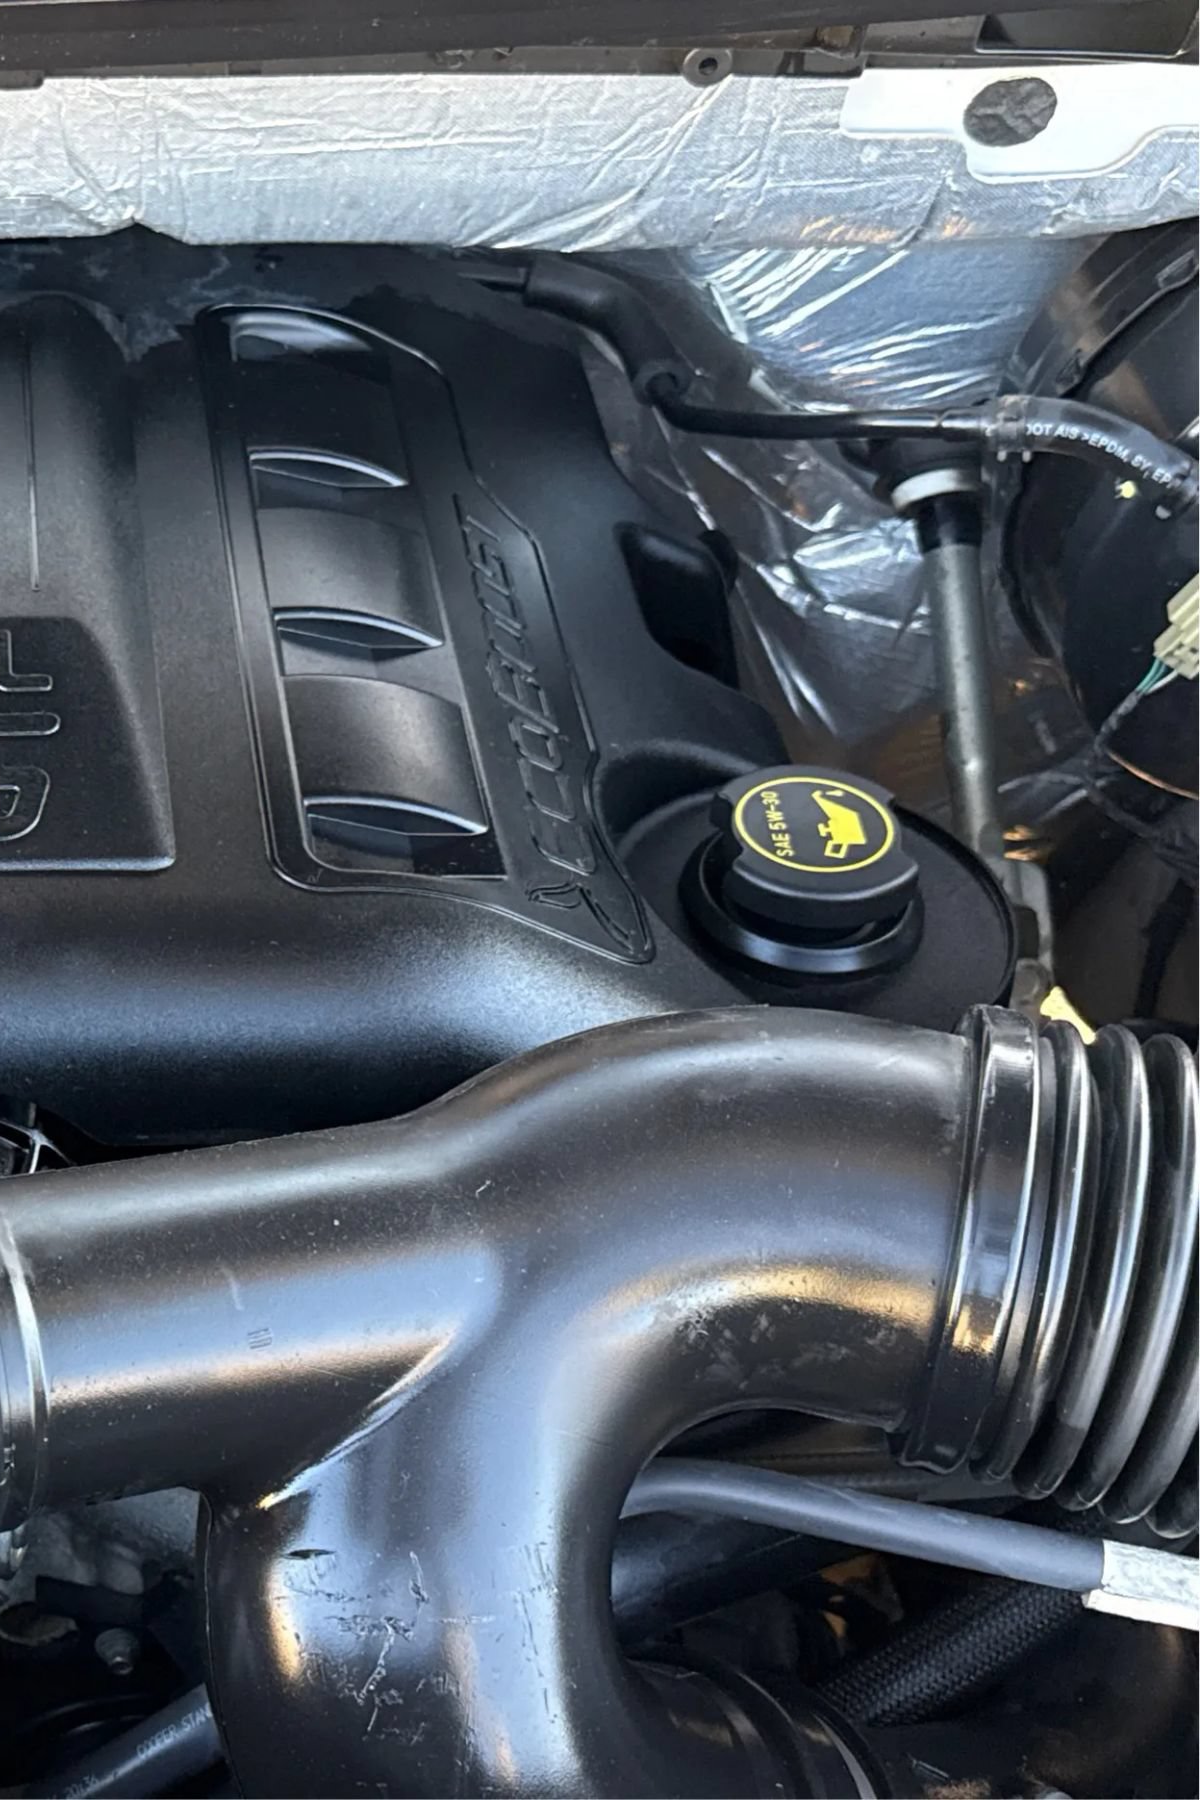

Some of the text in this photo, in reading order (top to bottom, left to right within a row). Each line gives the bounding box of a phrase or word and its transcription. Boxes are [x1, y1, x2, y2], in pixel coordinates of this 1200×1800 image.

[453, 495, 598, 876] ECOBOOST
[760, 790, 795, 857] SAE 5W-30
